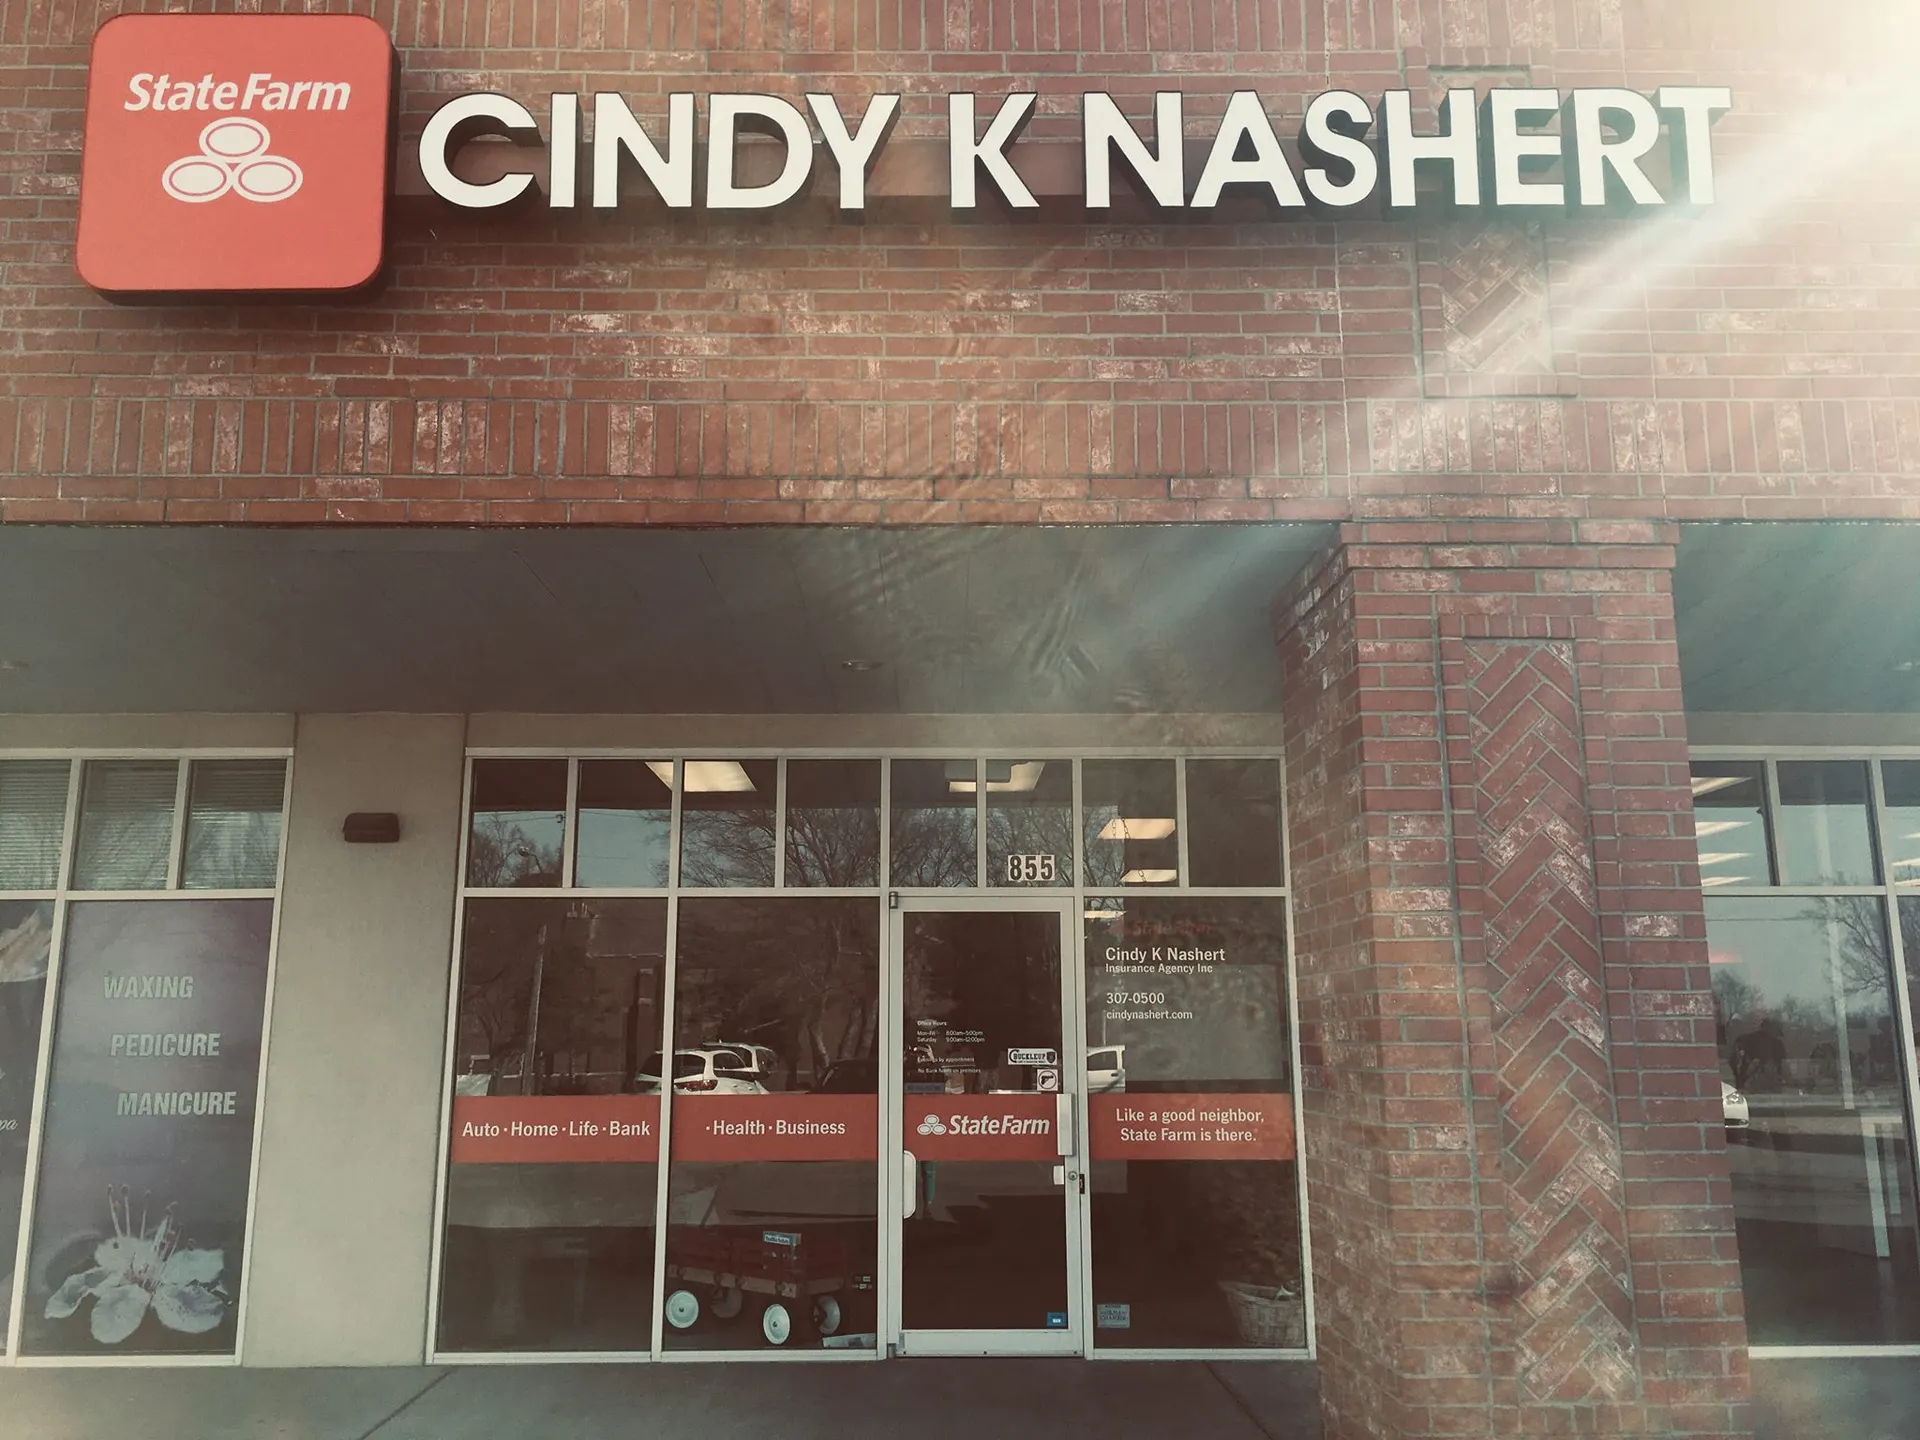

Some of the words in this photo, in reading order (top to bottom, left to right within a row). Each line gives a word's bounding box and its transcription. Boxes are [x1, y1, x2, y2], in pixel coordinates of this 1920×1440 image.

[418, 92, 898, 208] CINDY
[948, 91, 1037, 207] K
[1083, 86, 1731, 208] NASHERT
[1010, 855, 1053, 880] 855
[1105, 947, 1147, 964] Cindy
[1152, 947, 1162, 961] K
[1168, 947, 1225, 961] Nashert
[1105, 963, 1155, 973] Insurance
[1158, 963, 1194, 974] Agency
[1197, 963, 1213, 973] Inc
[103, 976, 194, 998] WAXING
[1106, 992, 1165, 1004] 307-0500
[1106, 1010, 1193, 1020] cindynashert.com
[110, 1033, 221, 1057] PEDICURE
[117, 1091, 237, 1115] MANICURE
[1116, 1108, 1145, 1122] Like
[1149, 1111, 1157, 1122] a
[1161, 1108, 1195, 1124] good
[462, 1121, 500, 1137] Auto
[511, 1121, 558, 1137] Home
[569, 1121, 598, 1136] Life
[609, 1120, 650, 1136] Bank
[776, 1119, 846, 1135] Business
[1120, 1127, 1157, 1141] State
[1161, 1127, 1196, 1141] Farm
[1200, 1128, 1212, 1141] is
[1215, 1127, 1257, 1141] there.
